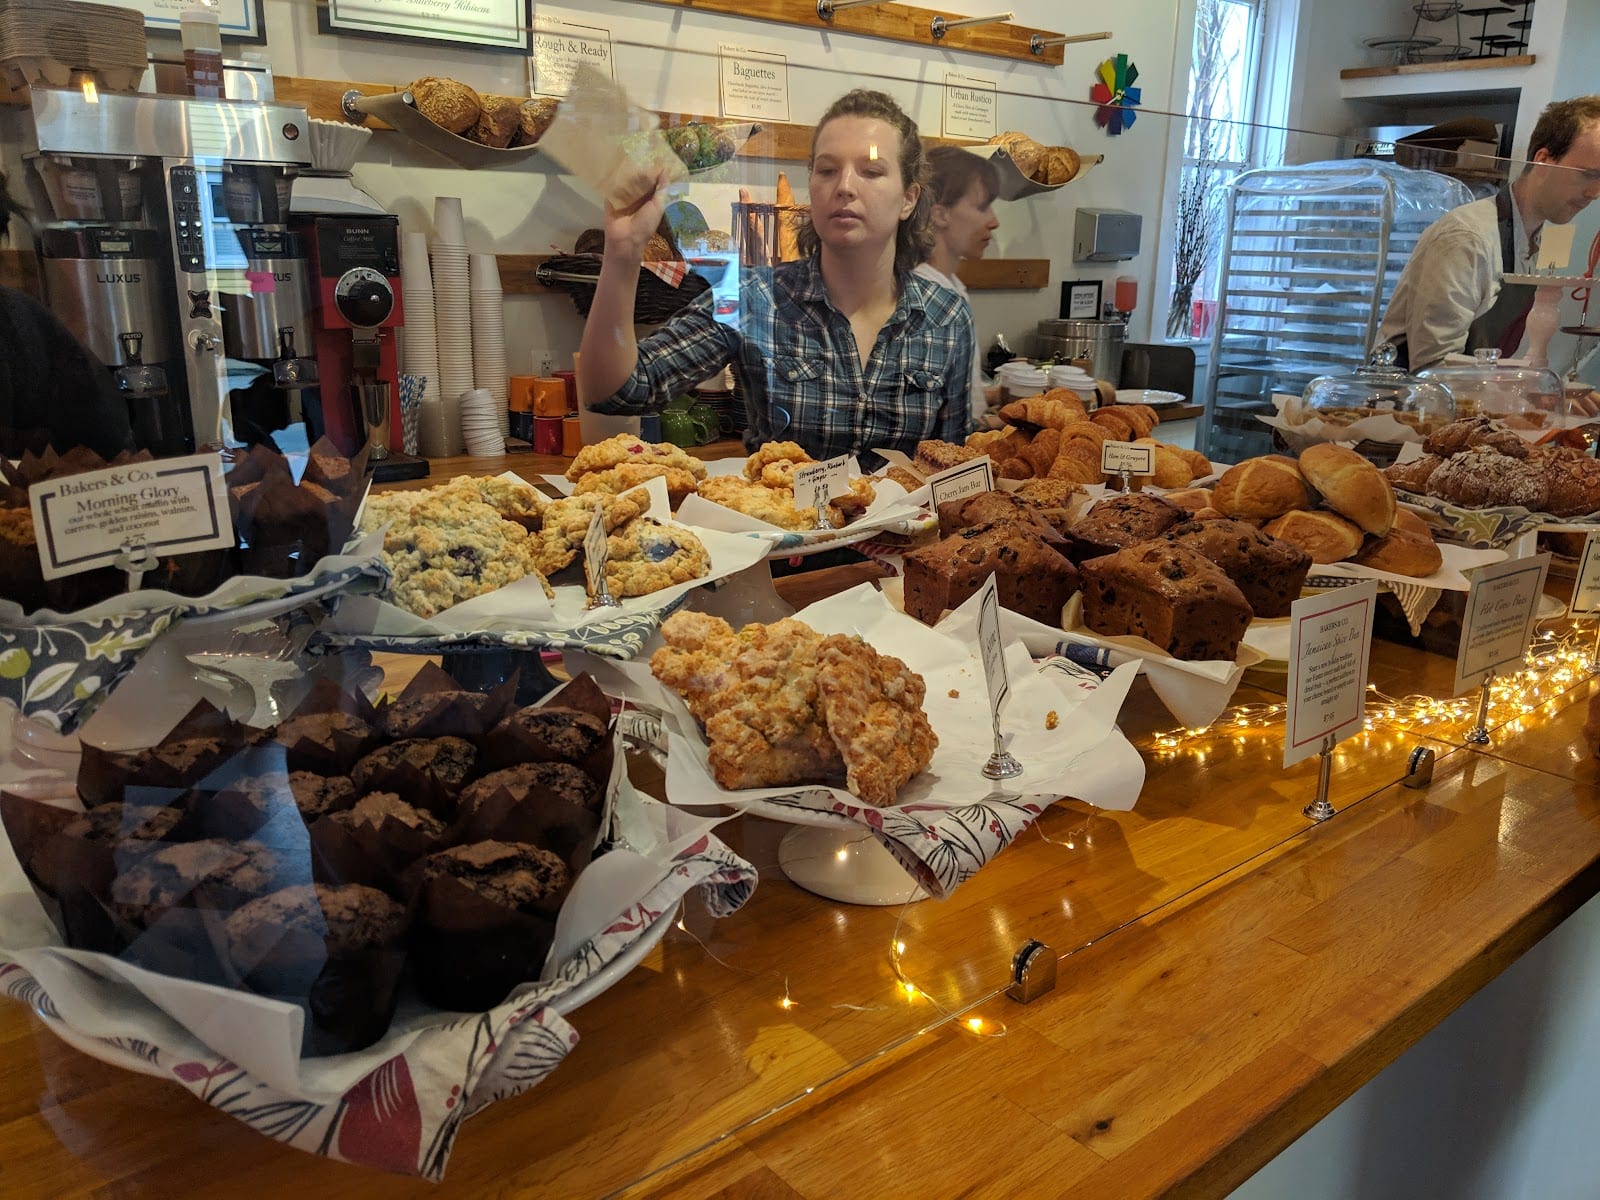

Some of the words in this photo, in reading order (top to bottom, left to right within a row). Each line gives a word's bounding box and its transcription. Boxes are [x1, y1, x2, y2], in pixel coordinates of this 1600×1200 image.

[535, 36, 565, 55] Rough
[568, 40, 580, 53] &
[580, 42, 608, 60] Ready
[733, 62, 776, 80] Baguettes
[950, 88, 969, 101] Urban
[971, 91, 992, 105] Rustico
[97, 274, 141, 284] LUXUS
[60, 479, 109, 497] Bakers
[111, 474, 126, 486] &
[128, 470, 154, 484] Co.
[940, 490, 958, 501] Cherry
[959, 485, 970, 494] Jam
[971, 481, 981, 490] Bar
[77, 492, 138, 514] Morning
[140, 486, 181, 500] Glory
[87, 509, 113, 521] whole
[114, 505, 139, 517] wheat
[141, 500, 169, 511] muffin
[170, 496, 190, 508] with
[100, 516, 129, 531] golden
[108, 525, 124, 535] and
